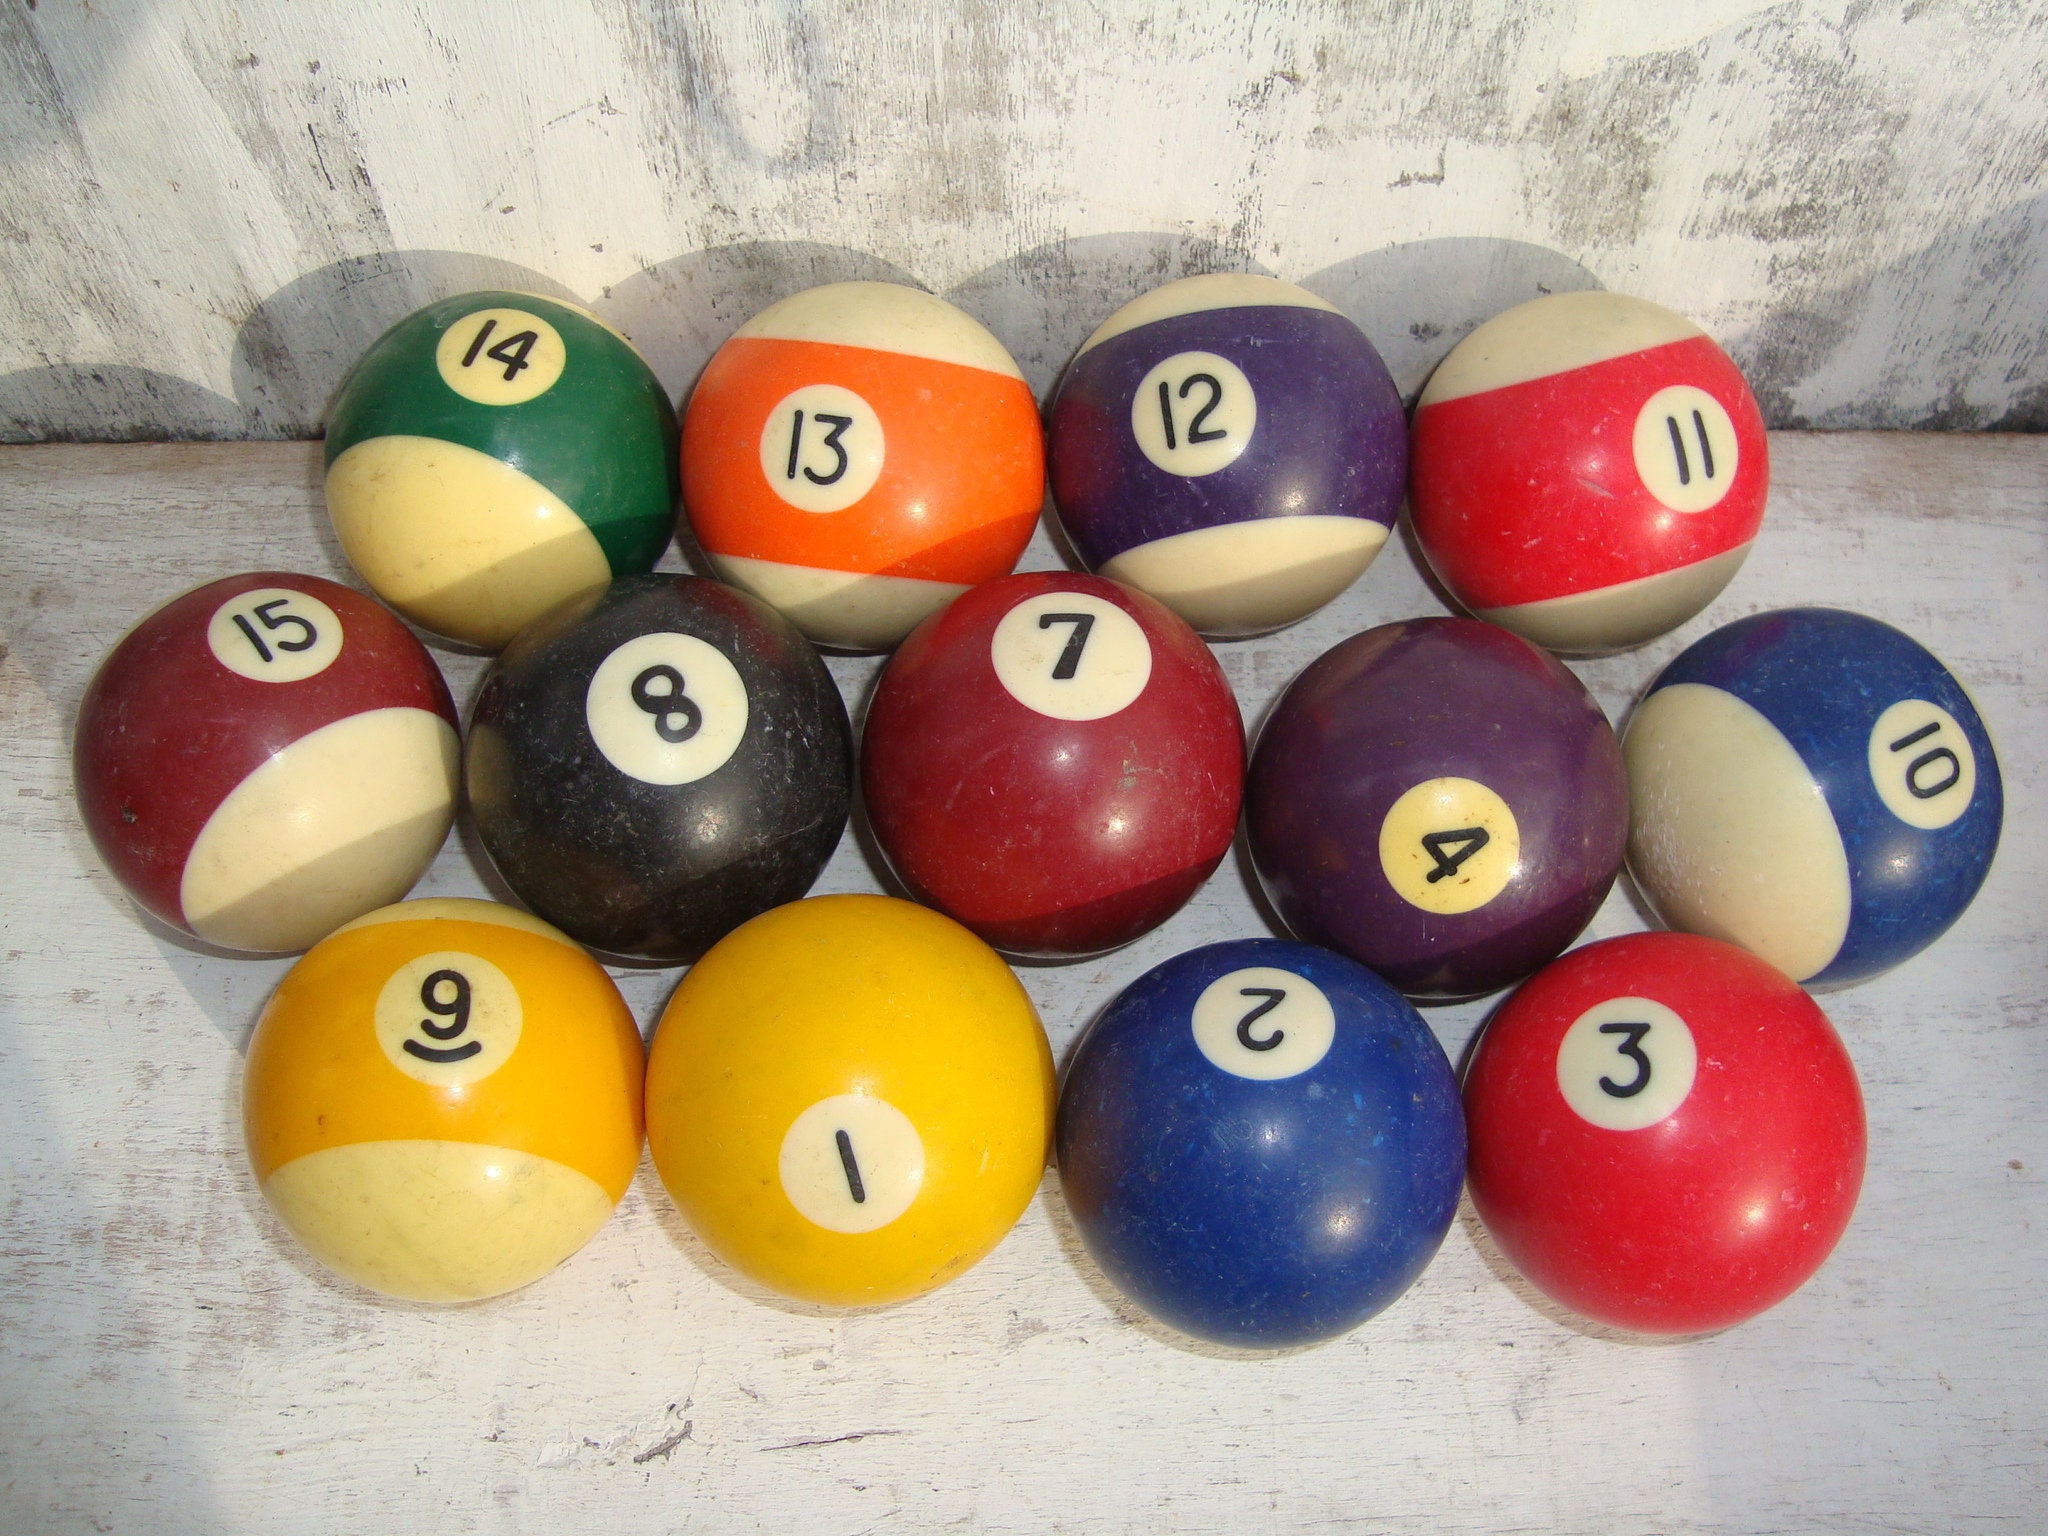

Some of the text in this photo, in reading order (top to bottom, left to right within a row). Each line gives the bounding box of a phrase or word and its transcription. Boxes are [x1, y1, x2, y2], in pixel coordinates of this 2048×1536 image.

[460, 317, 540, 383] 14
[785, 408, 854, 487] 13
[1157, 371, 1229, 452] 12
[1665, 408, 1716, 486] 11
[230, 597, 319, 664] 15
[1037, 611, 1097, 681] 7
[629, 663, 704, 745] 8
[1888, 720, 1962, 801] 10
[1419, 825, 1491, 885] 4
[419, 967, 473, 1042] 9
[1235, 986, 1288, 1053] 2
[1597, 1021, 1653, 1100] 3
[834, 1128, 867, 1205] 1
